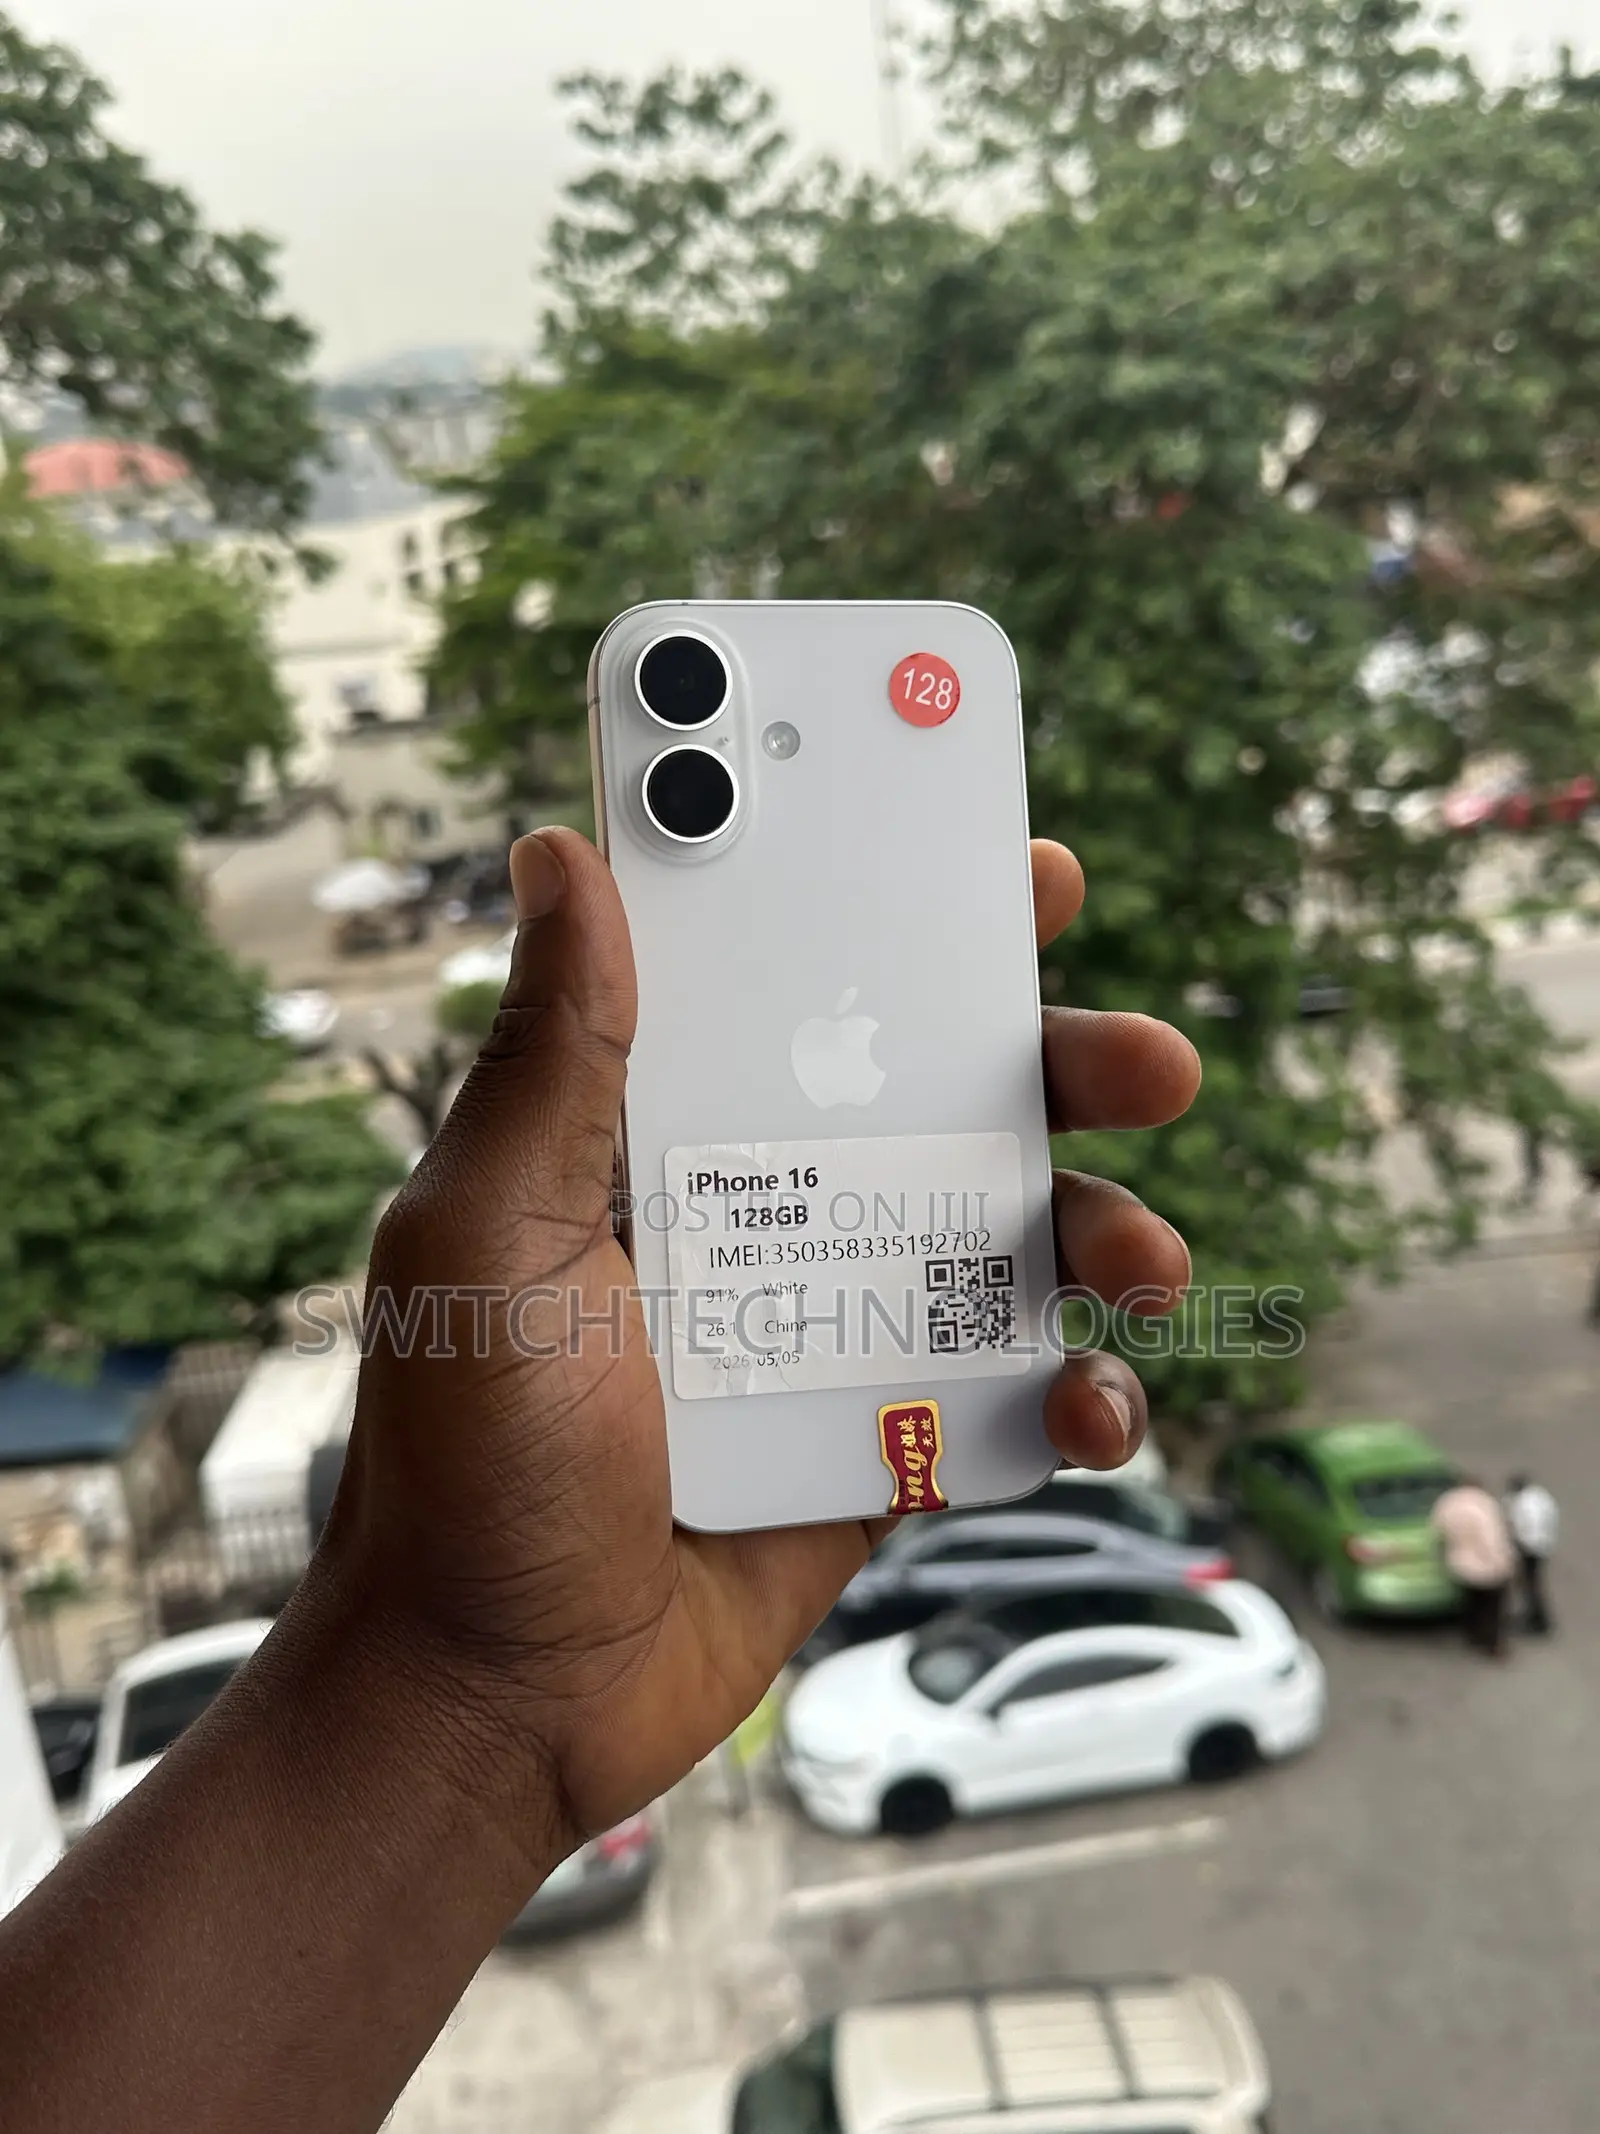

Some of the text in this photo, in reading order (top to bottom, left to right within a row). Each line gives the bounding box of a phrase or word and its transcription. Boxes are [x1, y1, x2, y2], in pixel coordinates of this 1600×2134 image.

[903, 667, 953, 710] 128
[687, 1166, 819, 1195] iPhone 16
[731, 1204, 809, 1228] 128GB
[709, 1230, 992, 1269] IMEI:350358335192702
[705, 1281, 809, 1304] 91% White
[764, 1318, 808, 1334] China
